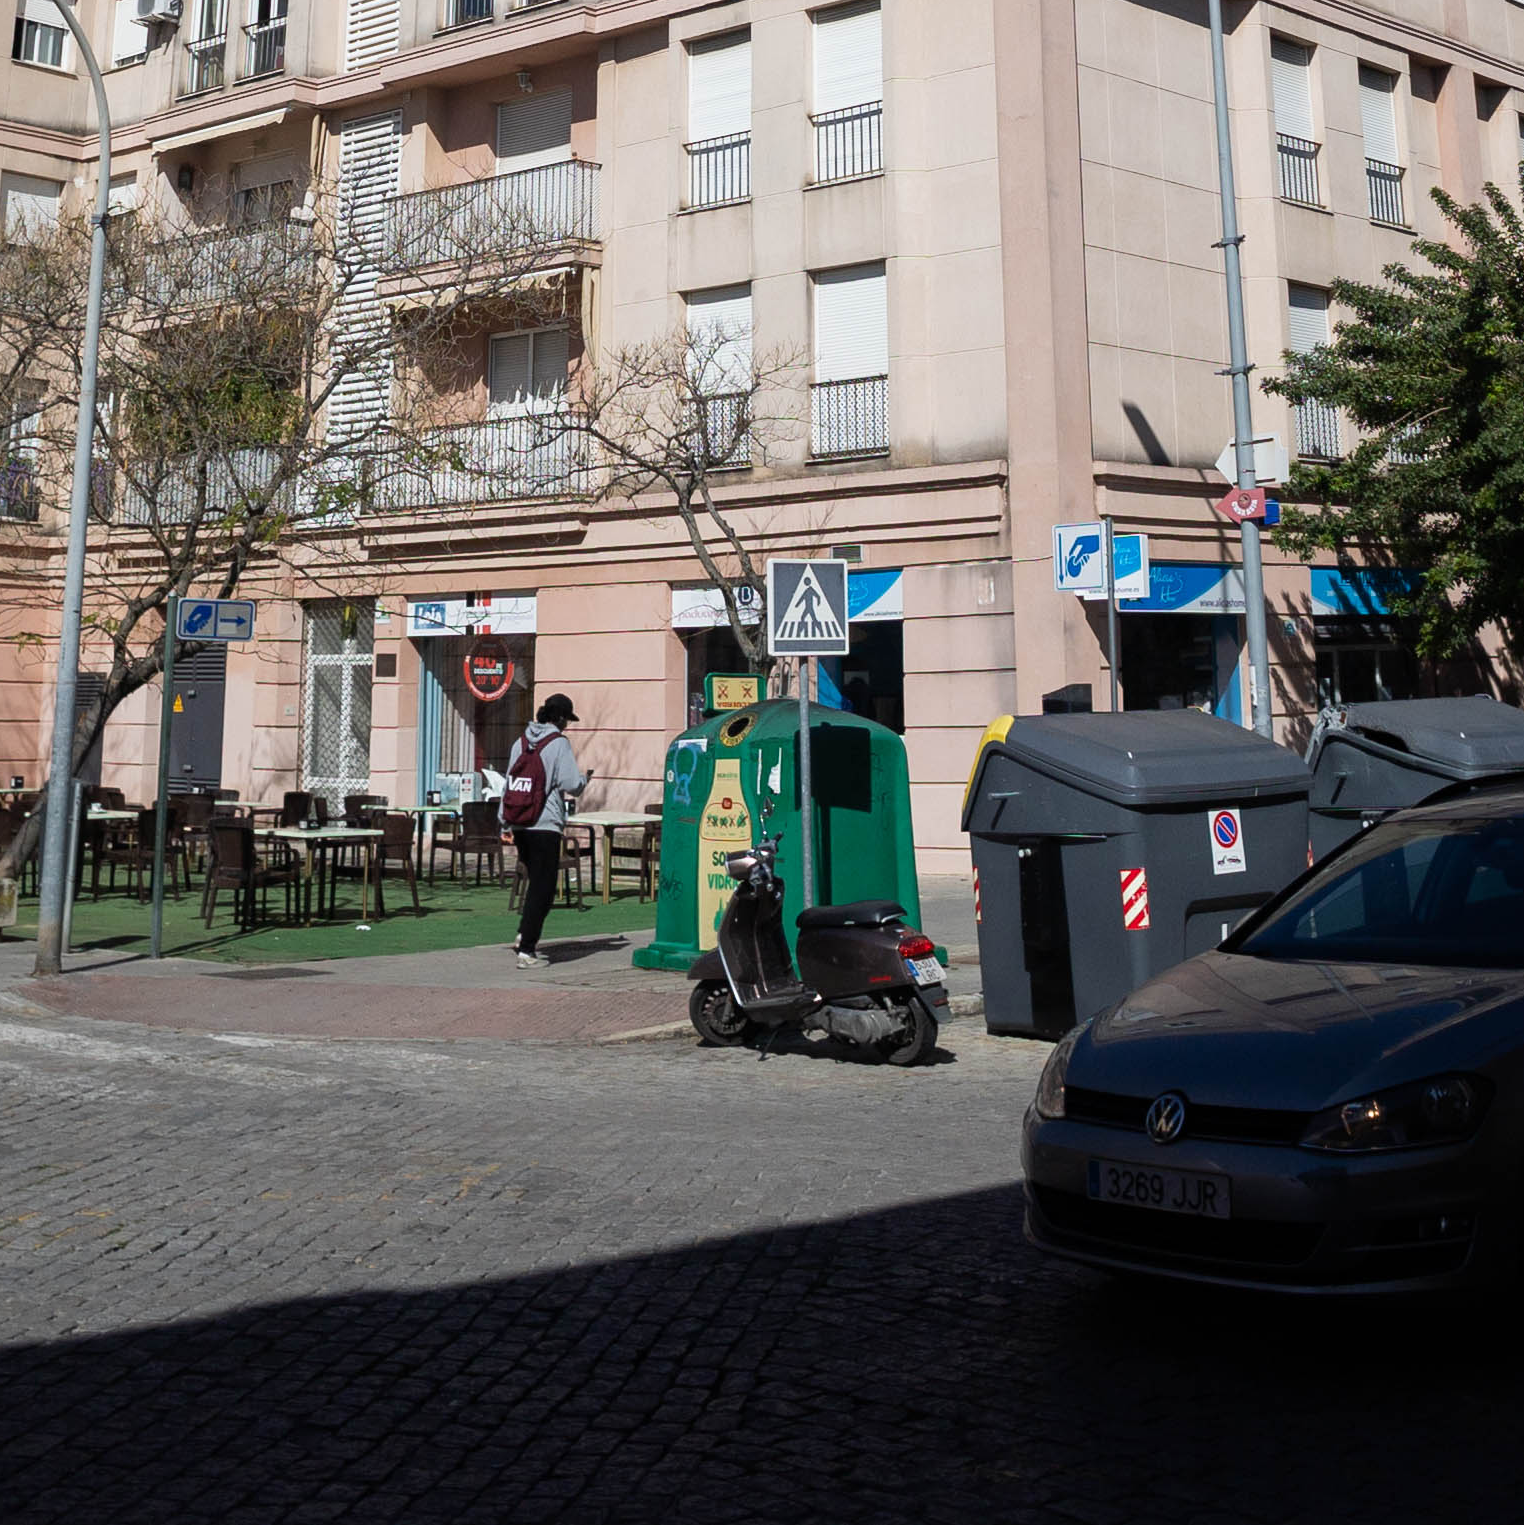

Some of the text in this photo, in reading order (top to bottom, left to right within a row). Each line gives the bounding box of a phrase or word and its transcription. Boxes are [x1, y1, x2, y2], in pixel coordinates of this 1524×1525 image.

[712, 851, 727, 866] SO
[1108, 1167, 1218, 1214] 3269 JJR
